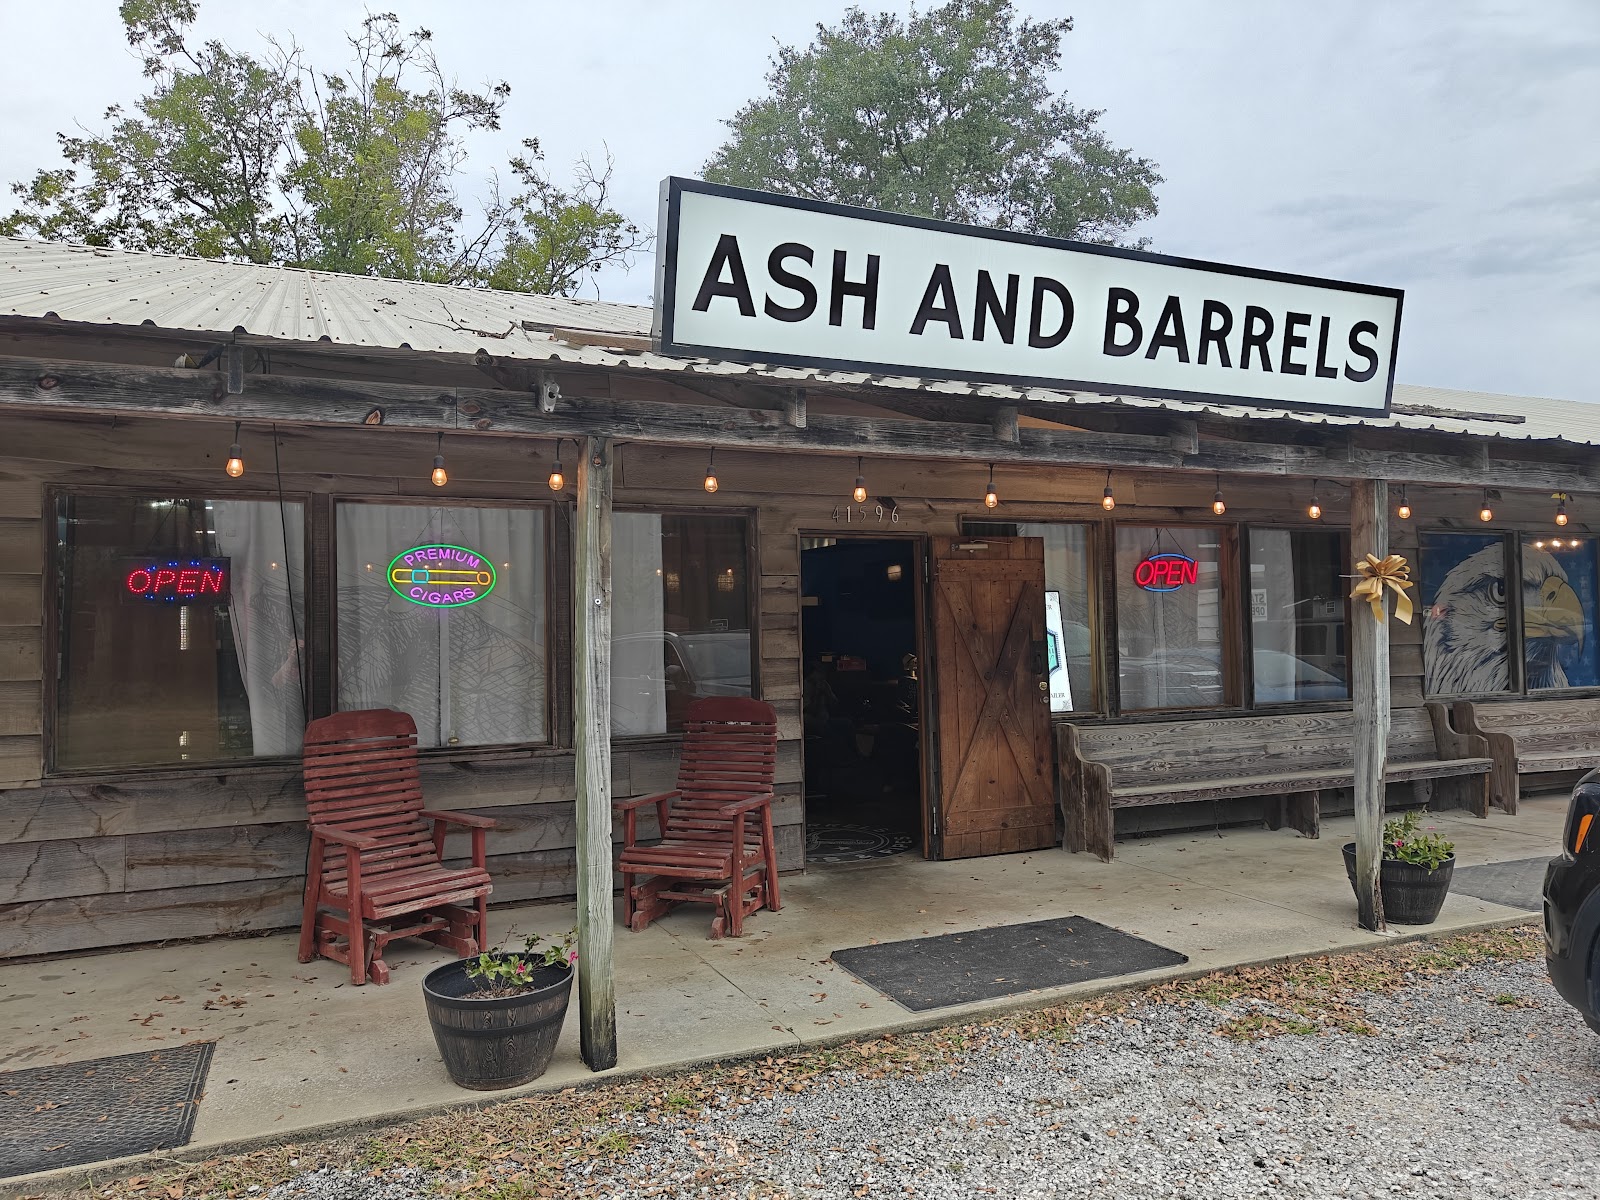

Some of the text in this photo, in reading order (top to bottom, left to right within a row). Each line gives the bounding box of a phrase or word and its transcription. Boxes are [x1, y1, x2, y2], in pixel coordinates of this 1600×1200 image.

[692, 233, 1379, 383] ASH AND BARRELS
[832, 505, 899, 523] 41596
[404, 548, 480, 568] PREMIUM
[128, 570, 223, 593] OPEN
[1135, 560, 1198, 585] OPEN
[410, 587, 475, 604] CIGARS
